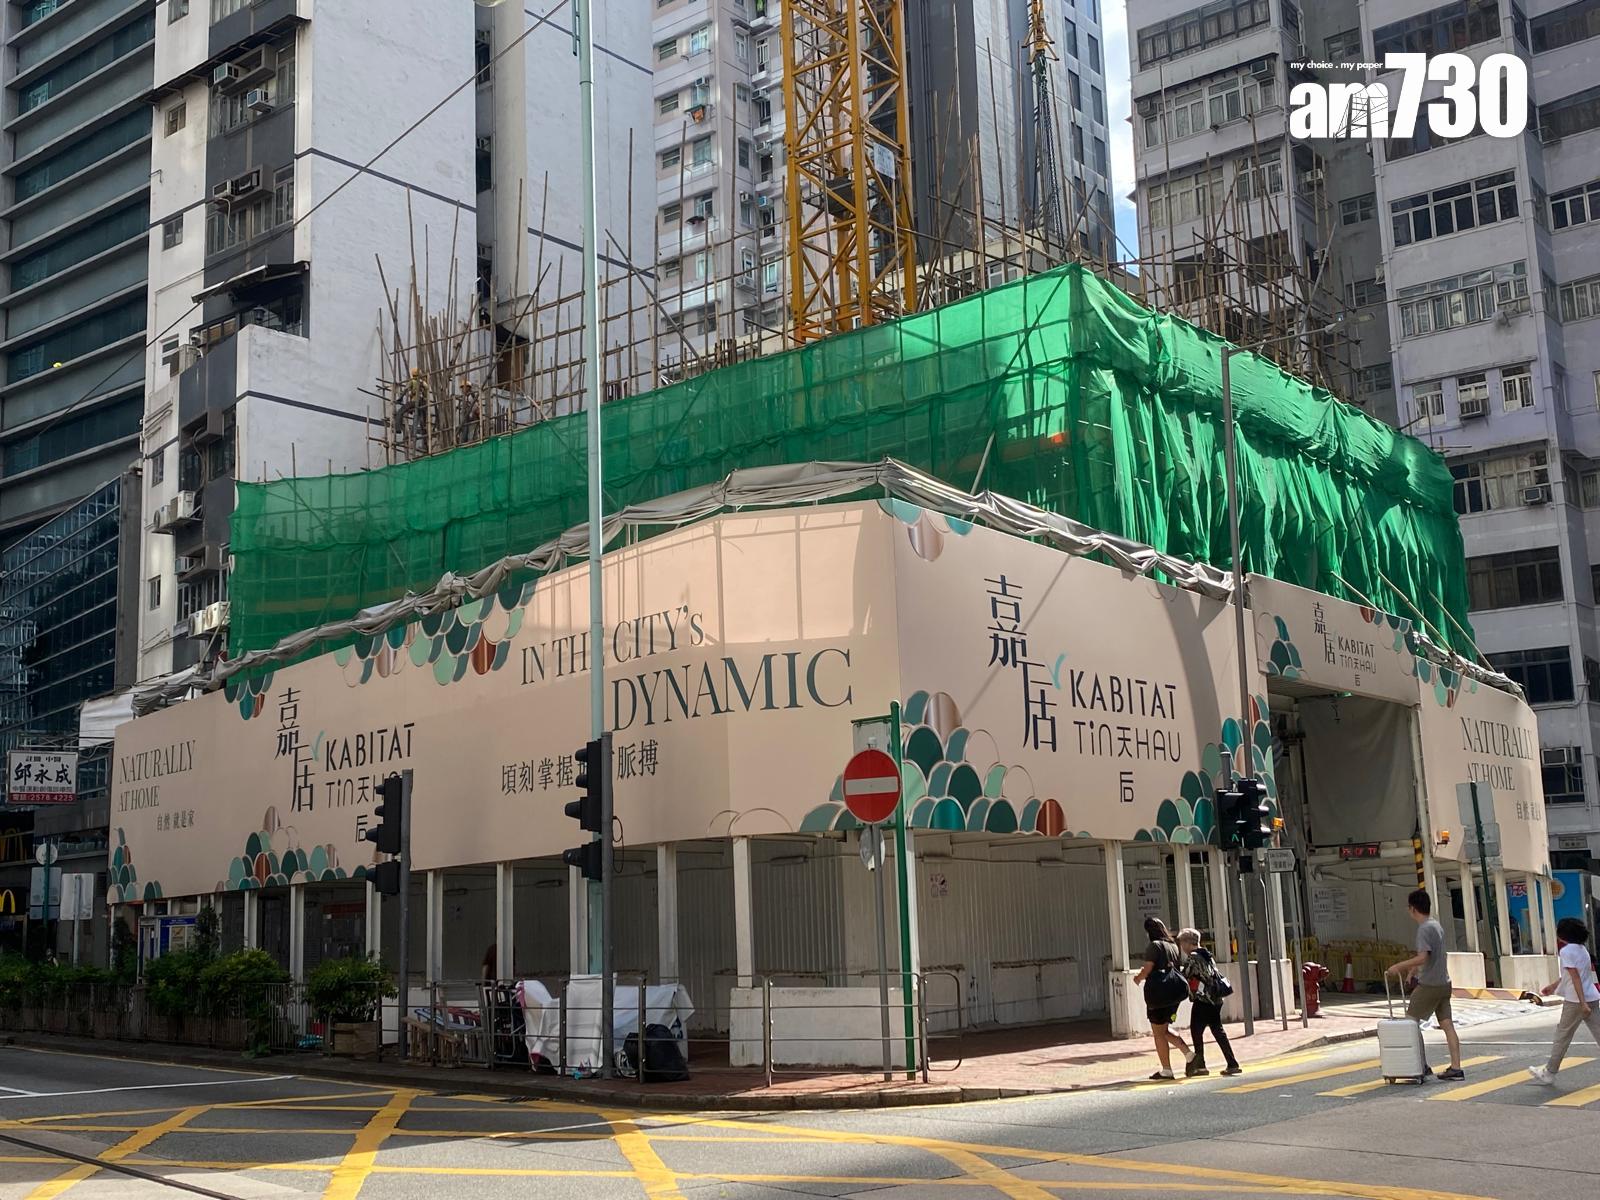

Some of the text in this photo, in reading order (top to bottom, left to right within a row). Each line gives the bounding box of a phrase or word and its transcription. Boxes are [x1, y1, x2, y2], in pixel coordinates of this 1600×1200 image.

[521, 643, 546, 686] IN
[552, 626, 605, 678] TH
[1337, 636, 1376, 659] KABITAT
[610, 648, 853, 732] DYNAMIC
[1070, 669, 1176, 720] KABITAT
[326, 722, 415, 772] KABITAT
[1460, 716, 1534, 761] NATURALLY
[13, 761, 73, 786] 邱永成
[119, 739, 196, 785] NATURALLY
[1467, 762, 1516, 791] AT HOME
[117, 785, 160, 813] AT HOME
